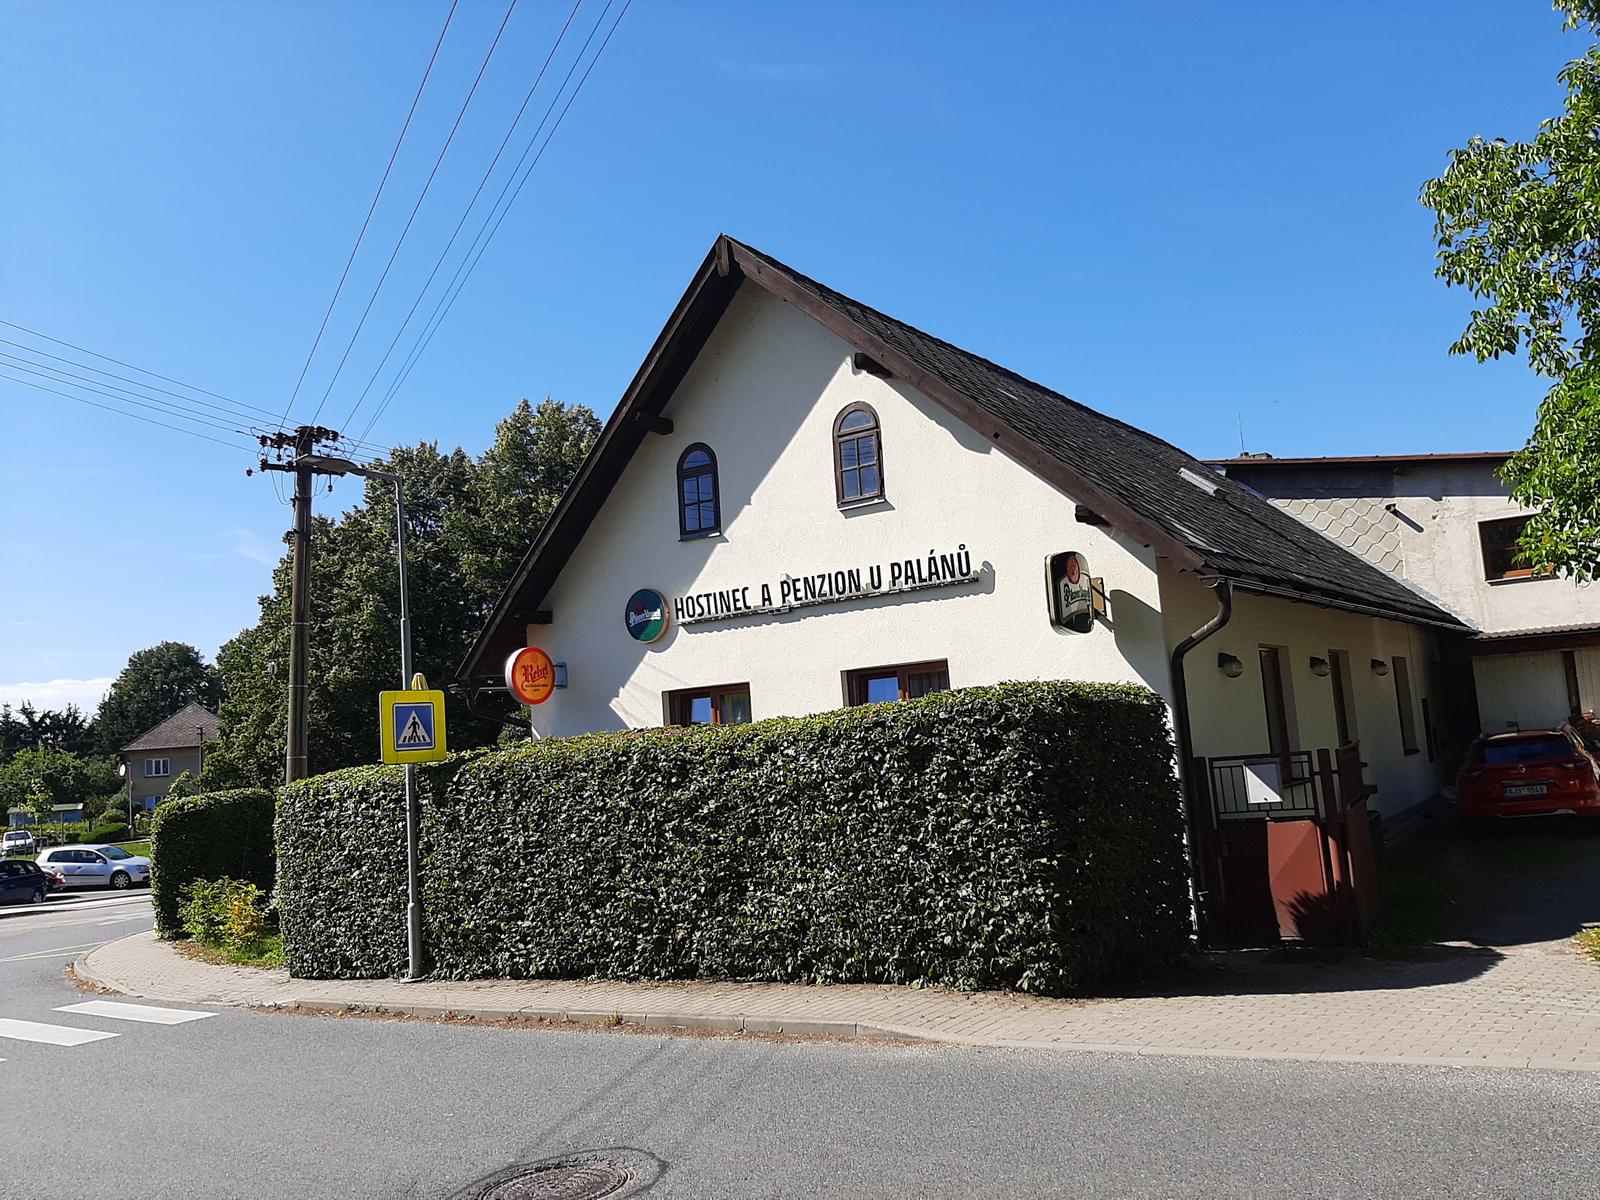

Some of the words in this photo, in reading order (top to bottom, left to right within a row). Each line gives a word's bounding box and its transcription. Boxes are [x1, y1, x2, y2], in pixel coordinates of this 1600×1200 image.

[674, 587, 751, 620] HOSTINEC
[761, 583, 773, 607] A
[780, 568, 861, 607] PENZION
[869, 564, 882, 590] U
[890, 543, 972, 587] PALÁNŮ
